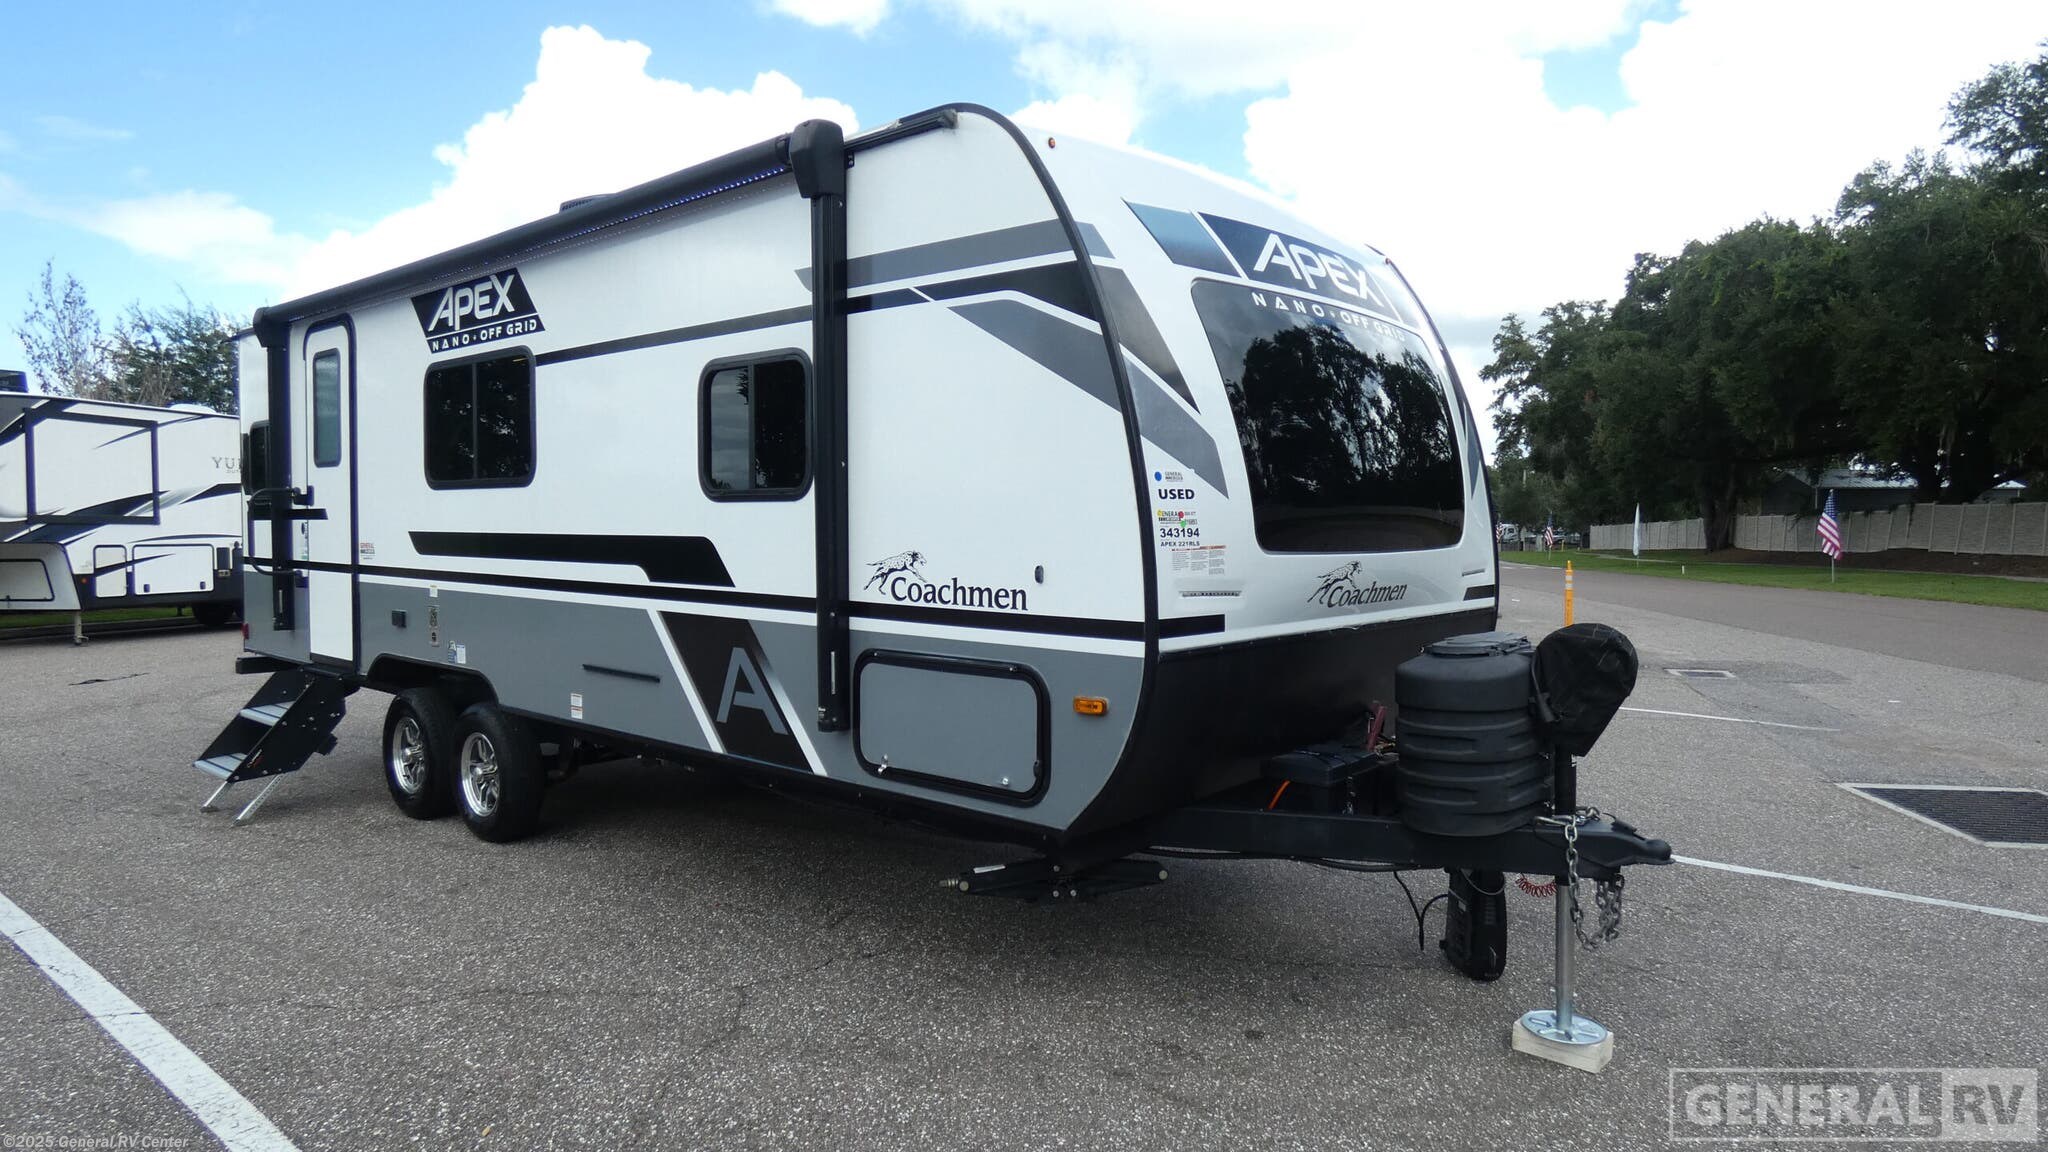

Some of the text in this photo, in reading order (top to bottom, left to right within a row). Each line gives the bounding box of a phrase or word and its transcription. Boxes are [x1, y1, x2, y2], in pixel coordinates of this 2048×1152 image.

[1254, 233, 1384, 307] APEX
[428, 274, 515, 331] APEX
[1252, 292, 1325, 317] NANO
[1340, 311, 1369, 329] OFF
[432, 319, 537, 351] NANO OFF GRID
[1158, 488, 1195, 500] USED
[1160, 527, 1200, 538] 343194
[891, 577, 1028, 611] Coachmen
[1327, 581, 1408, 608] Coachmen
[716, 647, 788, 735] A
